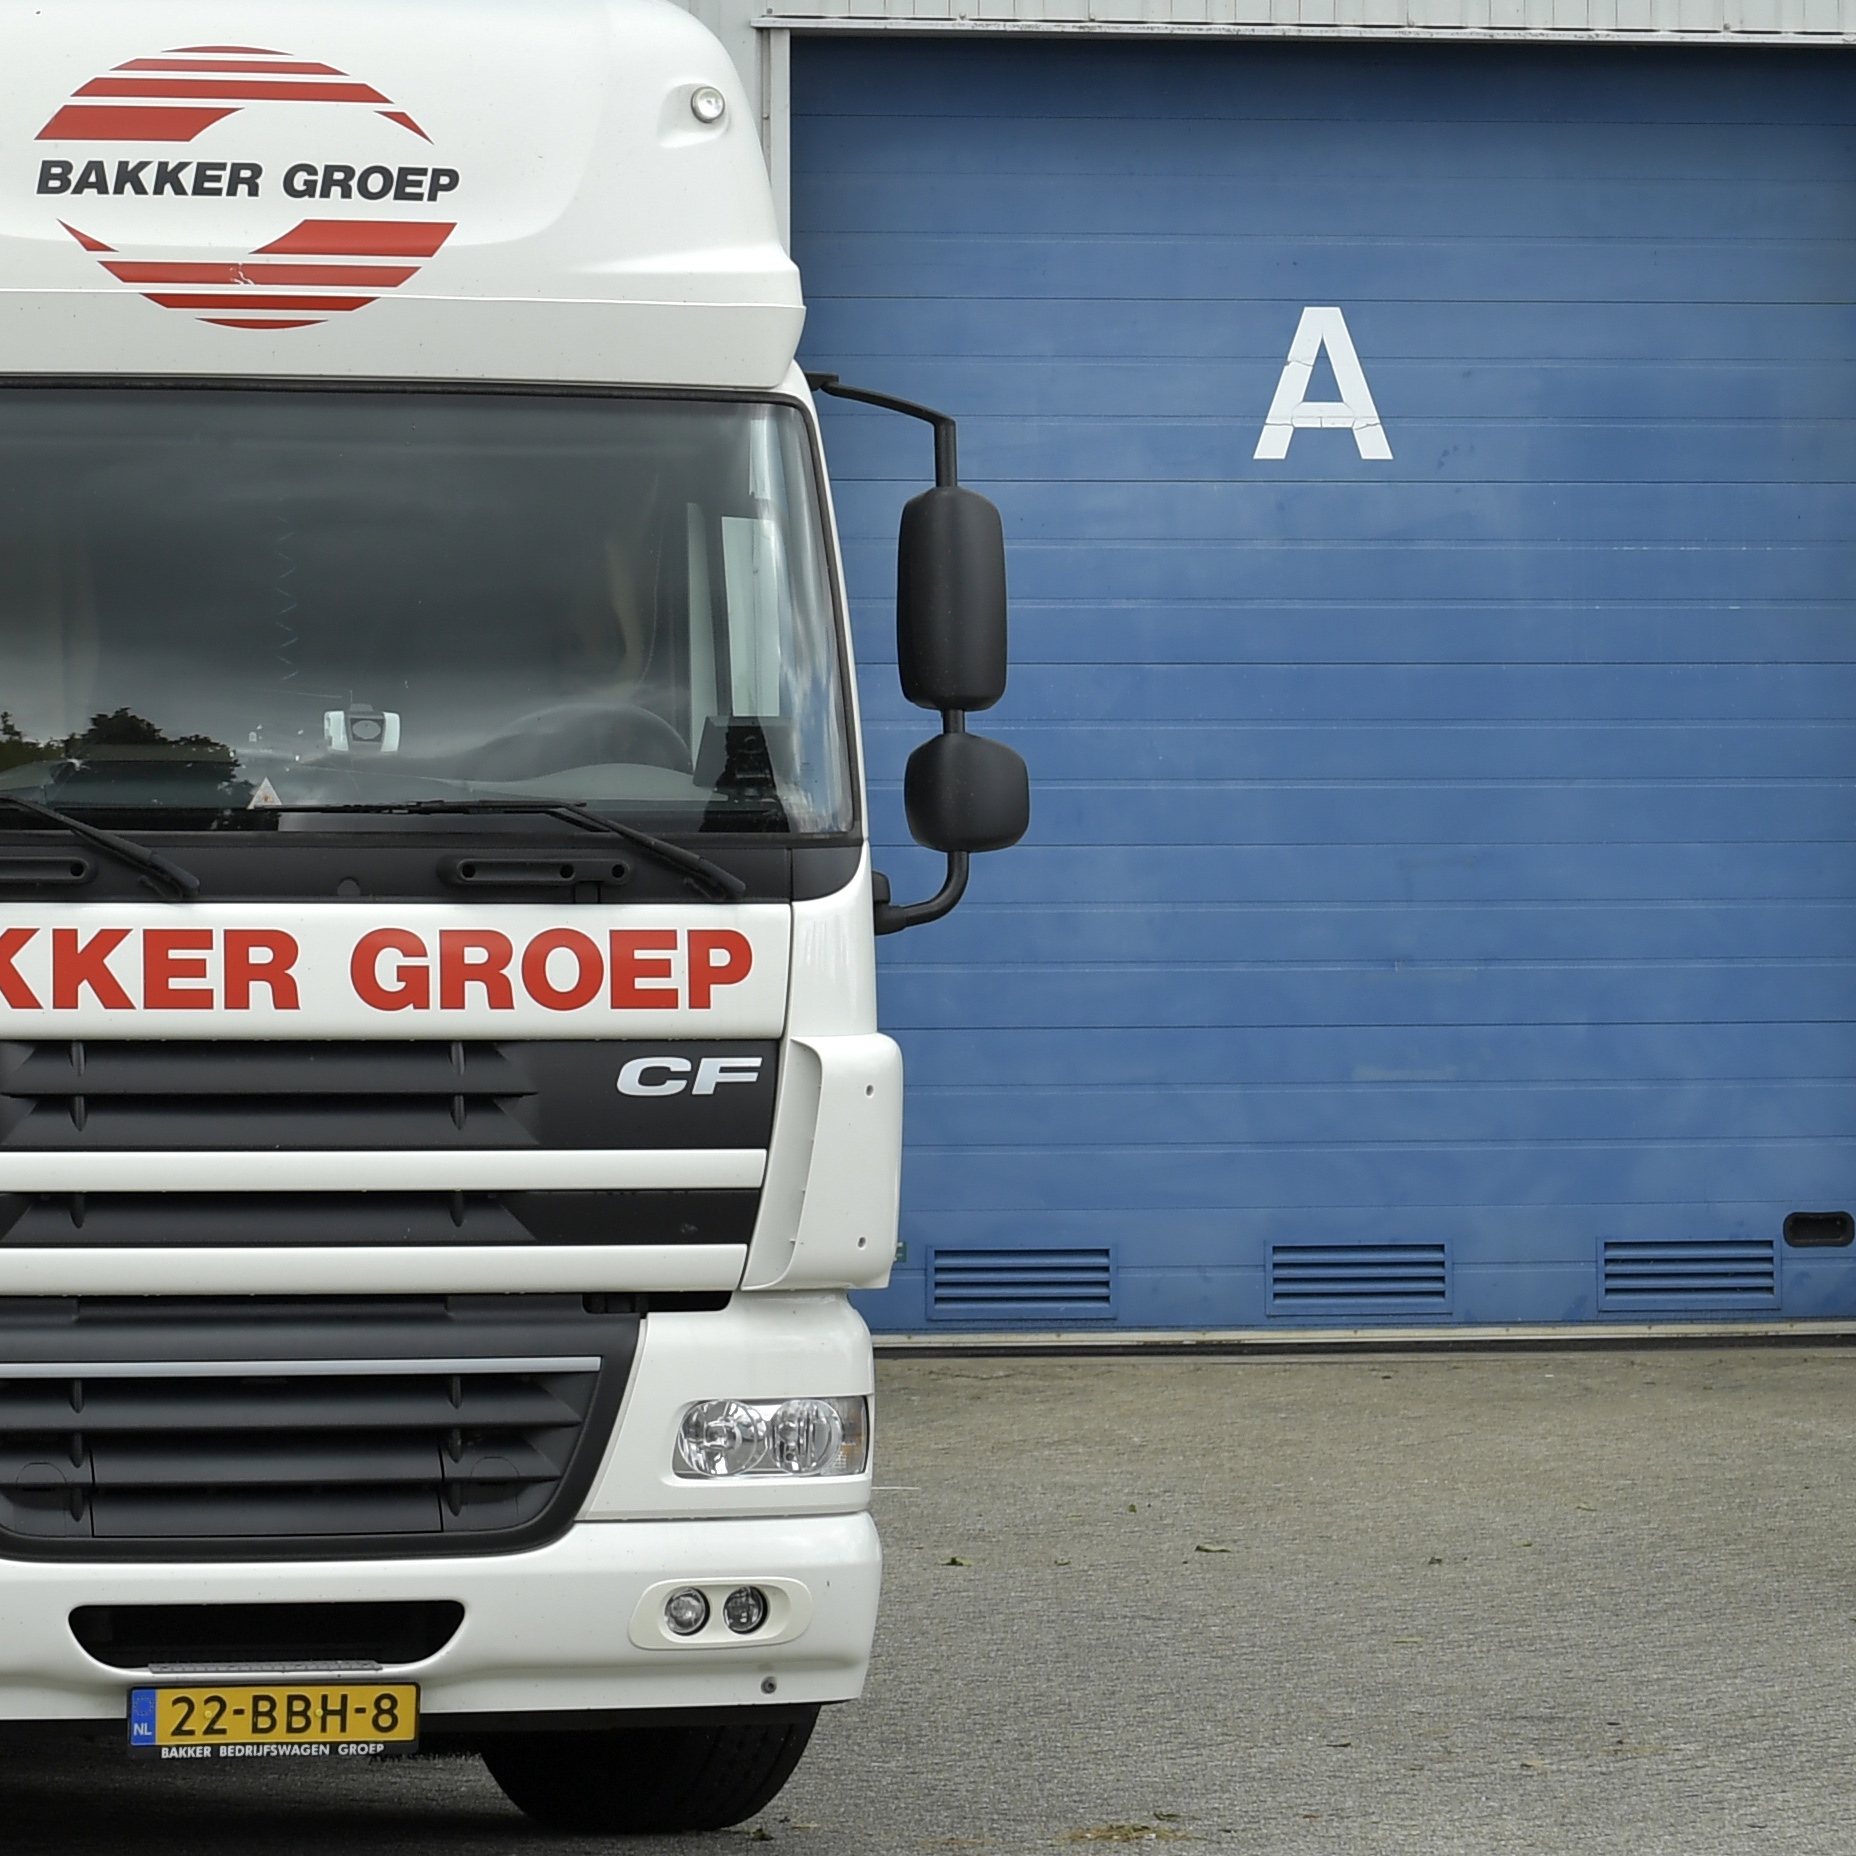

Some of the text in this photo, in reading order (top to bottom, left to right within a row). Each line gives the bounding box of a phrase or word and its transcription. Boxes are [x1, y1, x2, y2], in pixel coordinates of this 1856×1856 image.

[37, 159, 460, 202] BAKKER GROEP
[1254, 307, 1393, 460] A
[351, 928, 752, 1010] GROEP
[616, 1056, 763, 1096] CF
[133, 1723, 152, 1736] NL
[170, 1693, 399, 1737] 22-BBH-8
[161, 1743, 384, 1759] BAKKER BEDRIJFSWAGEN GROEP
